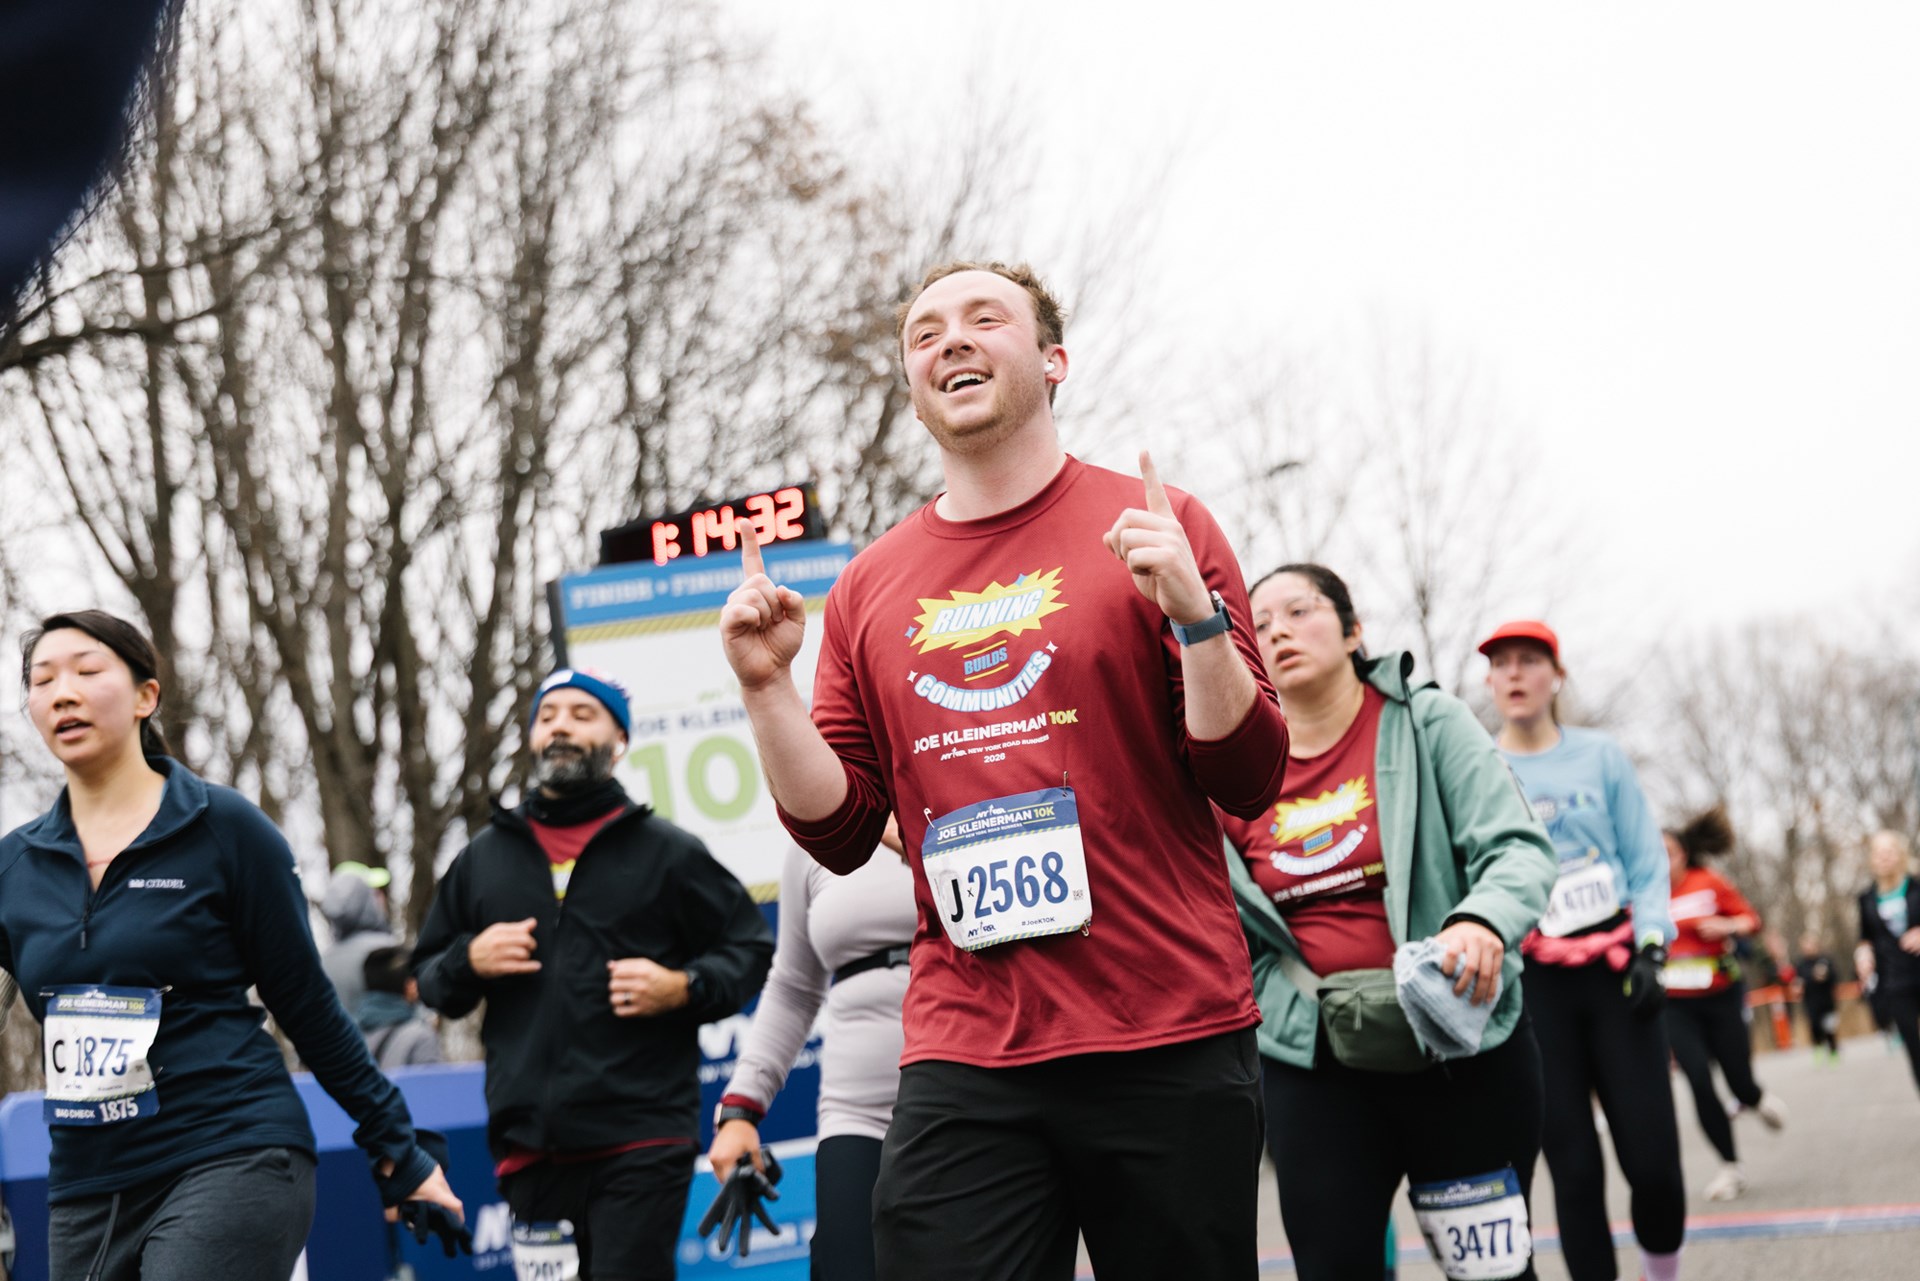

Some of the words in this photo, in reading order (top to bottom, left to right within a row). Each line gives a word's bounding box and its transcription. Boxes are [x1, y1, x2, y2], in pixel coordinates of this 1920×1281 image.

[929, 588, 1045, 635] RUNNING
[914, 650, 1052, 712] COMMUNITIES
[964, 647, 1008, 675] BUILDS
[913, 734, 940, 754] JOE
[942, 712, 1048, 746] KLEINERMAN
[1049, 709, 1079, 725] 10K
[983, 752, 1006, 764] 2026
[937, 826, 957, 841] JOE
[958, 810, 1032, 835] KLEINERMAN
[1033, 806, 1055, 818] 10K
[145, 879, 186, 889] CITADEL
[951, 879, 964, 923] J
[967, 851, 1069, 919] 2568
[52, 1039, 66, 1074] C
[74, 1036, 135, 1078] 1875
[99, 1096, 139, 1123] 1875
[1447, 1218, 1513, 1261] 3477
